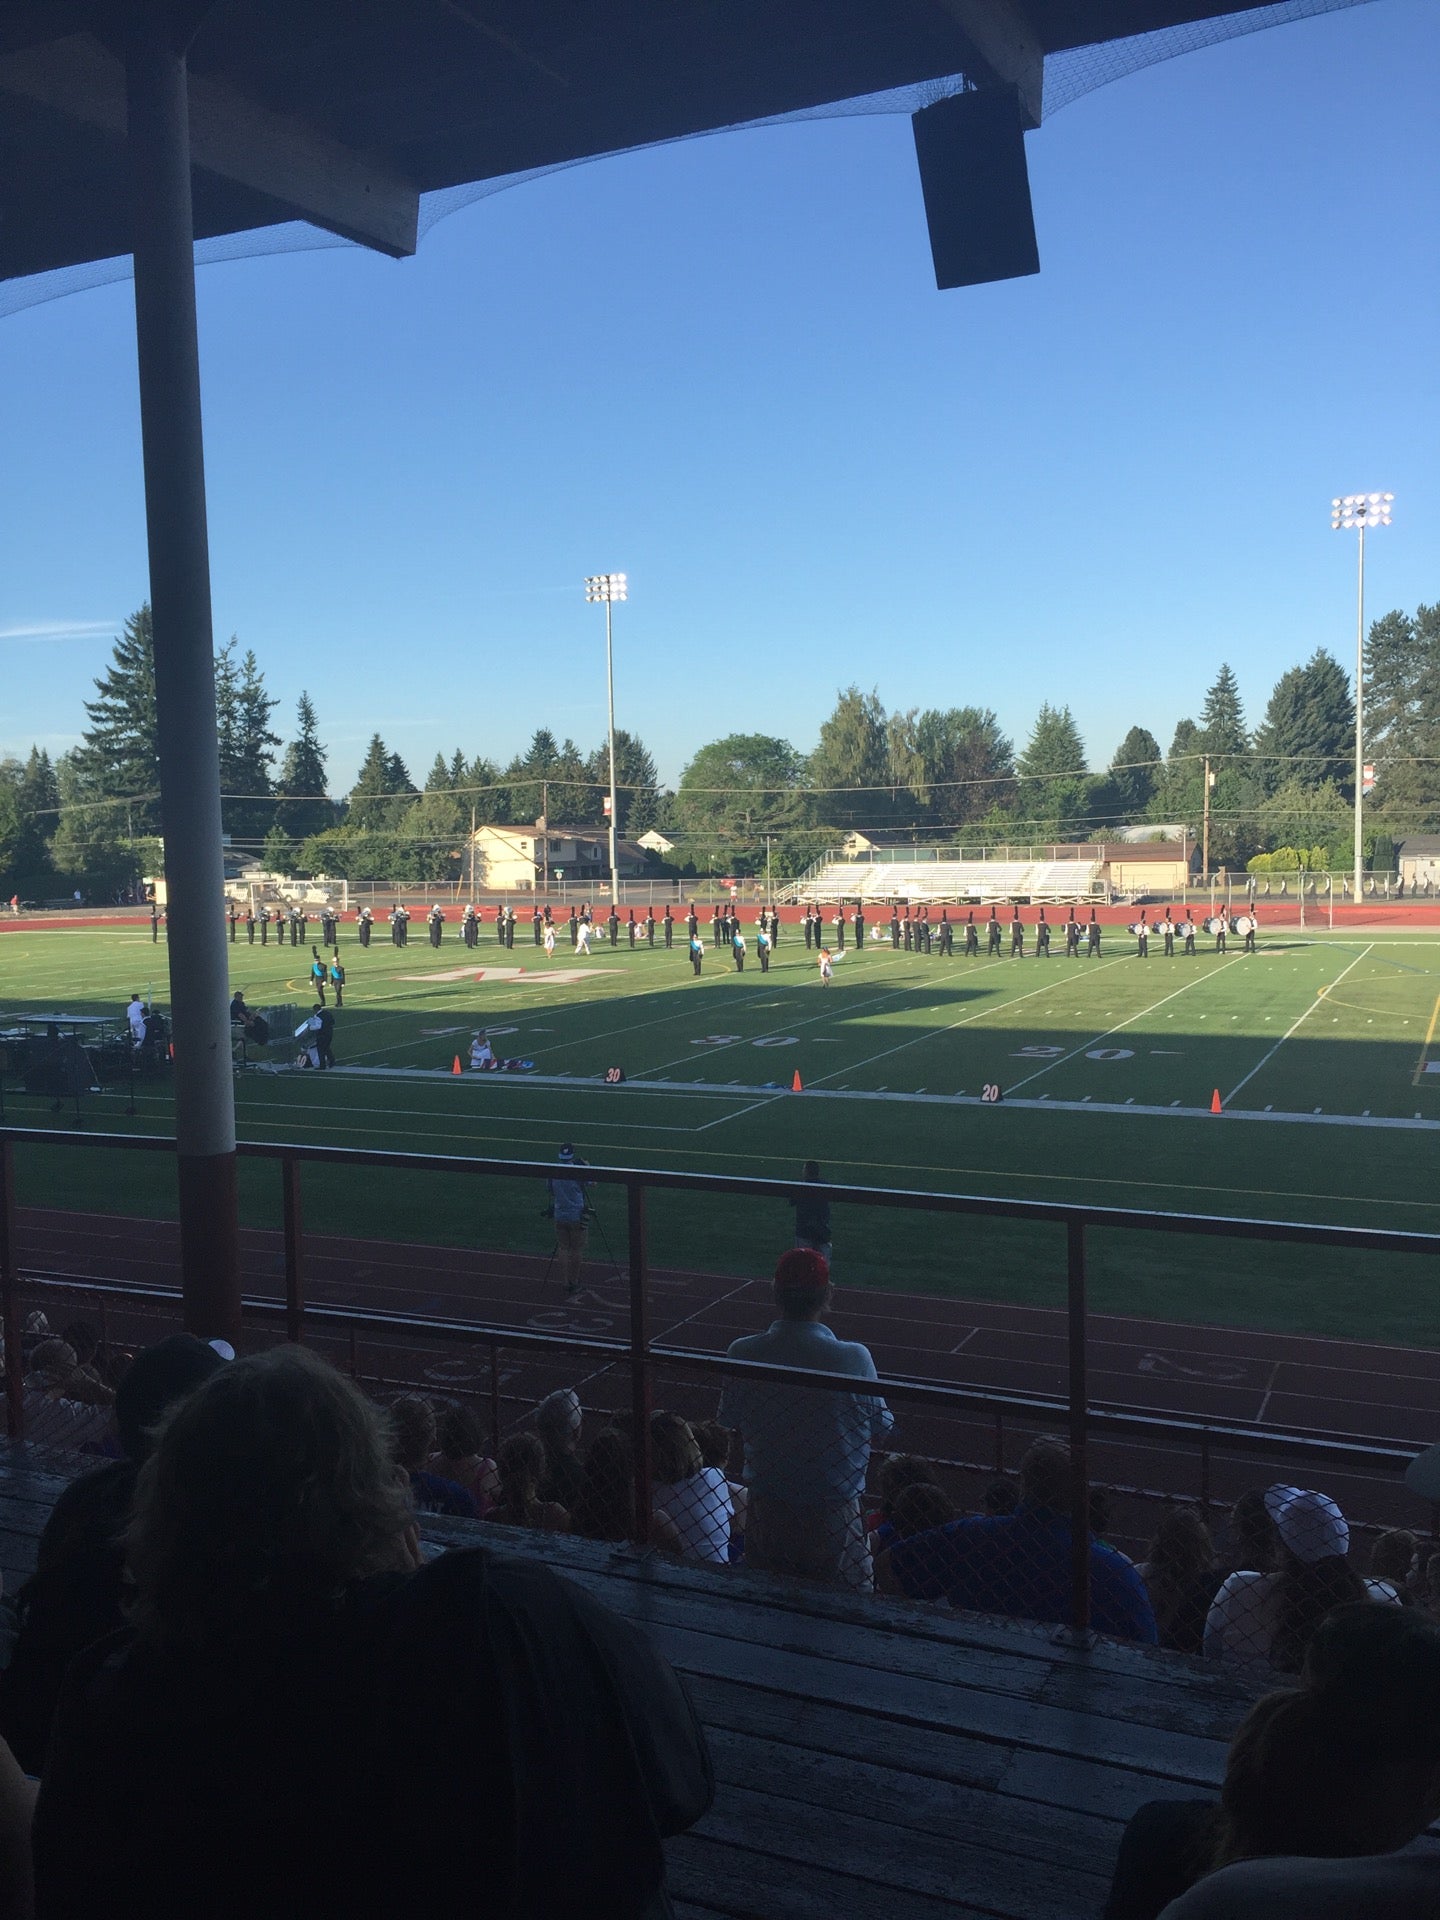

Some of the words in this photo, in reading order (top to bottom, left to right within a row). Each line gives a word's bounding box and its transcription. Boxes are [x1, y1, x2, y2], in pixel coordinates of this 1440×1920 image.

[1007, 1045, 1136, 1060] 20
[605, 1067, 621, 1083] 30
[982, 1083, 999, 1102] 20
